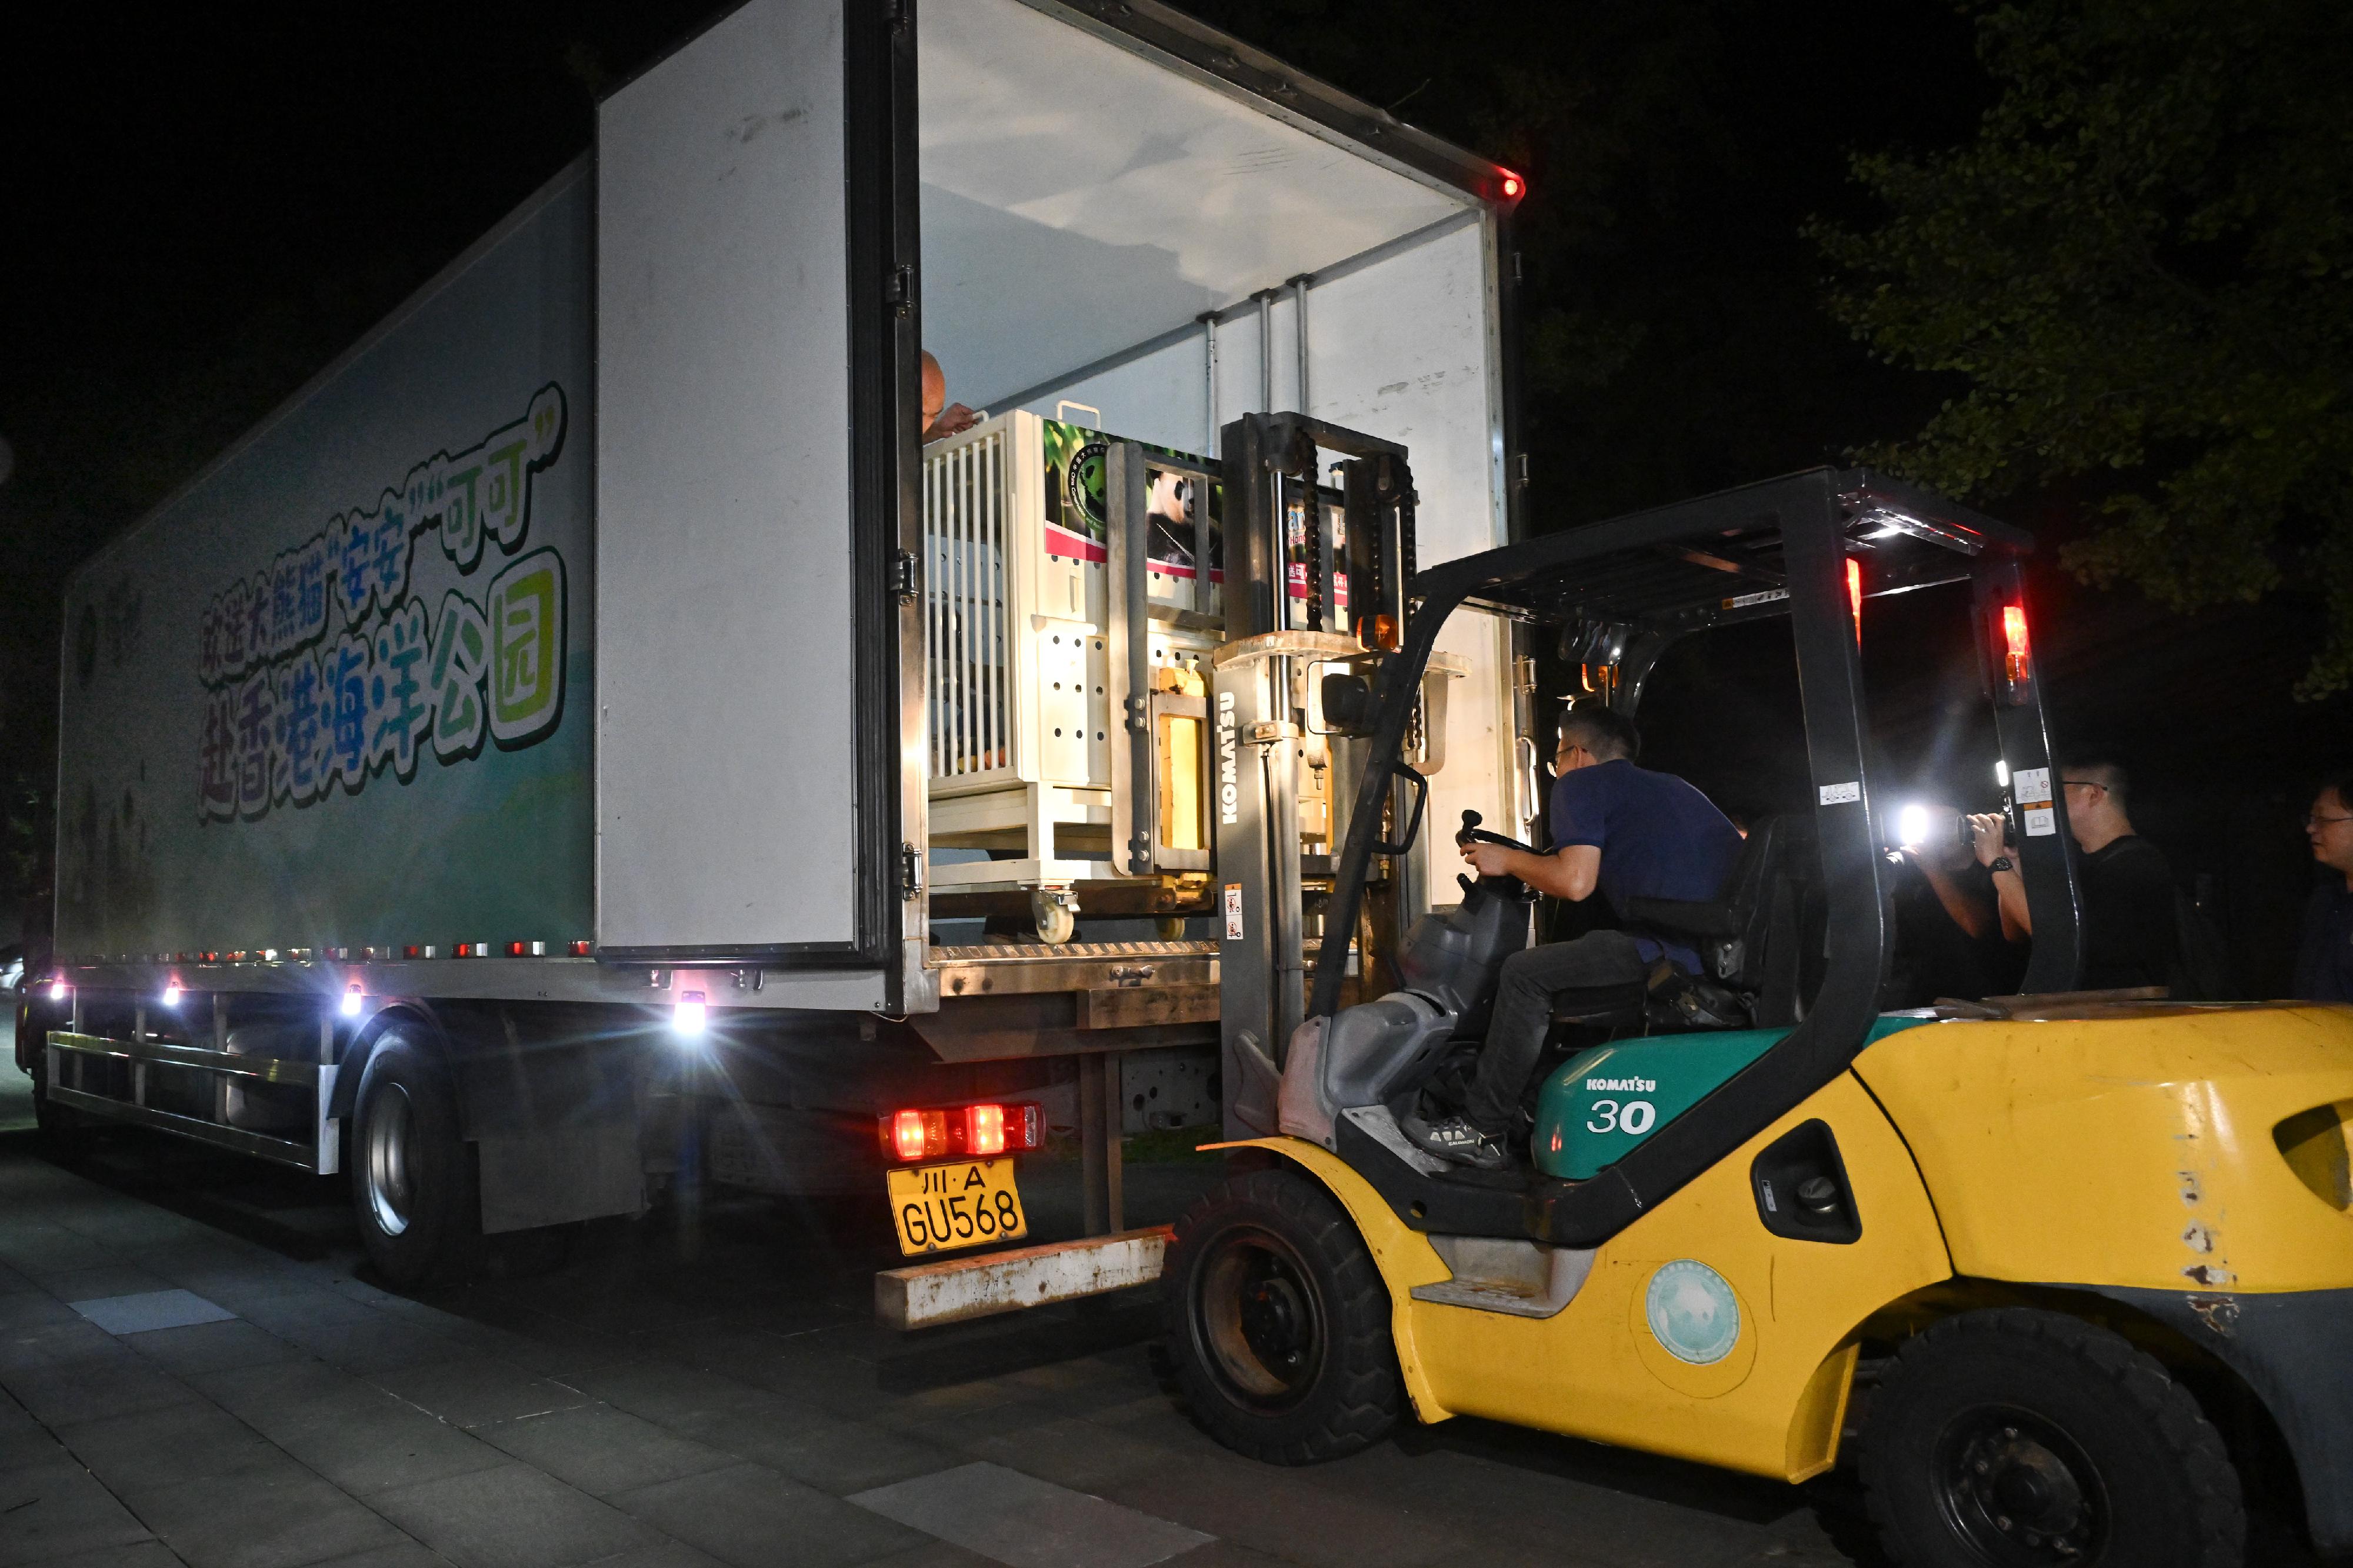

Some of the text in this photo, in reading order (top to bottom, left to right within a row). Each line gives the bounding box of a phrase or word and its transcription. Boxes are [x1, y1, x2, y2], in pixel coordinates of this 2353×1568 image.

[202, 567, 556, 802] 赴香港海洋公园
[1216, 691, 1238, 825] KOMATSU
[1586, 1076, 1657, 1092] KOMATSU
[1586, 1099, 1657, 1135] 30
[902, 1190, 1018, 1246] GU568
